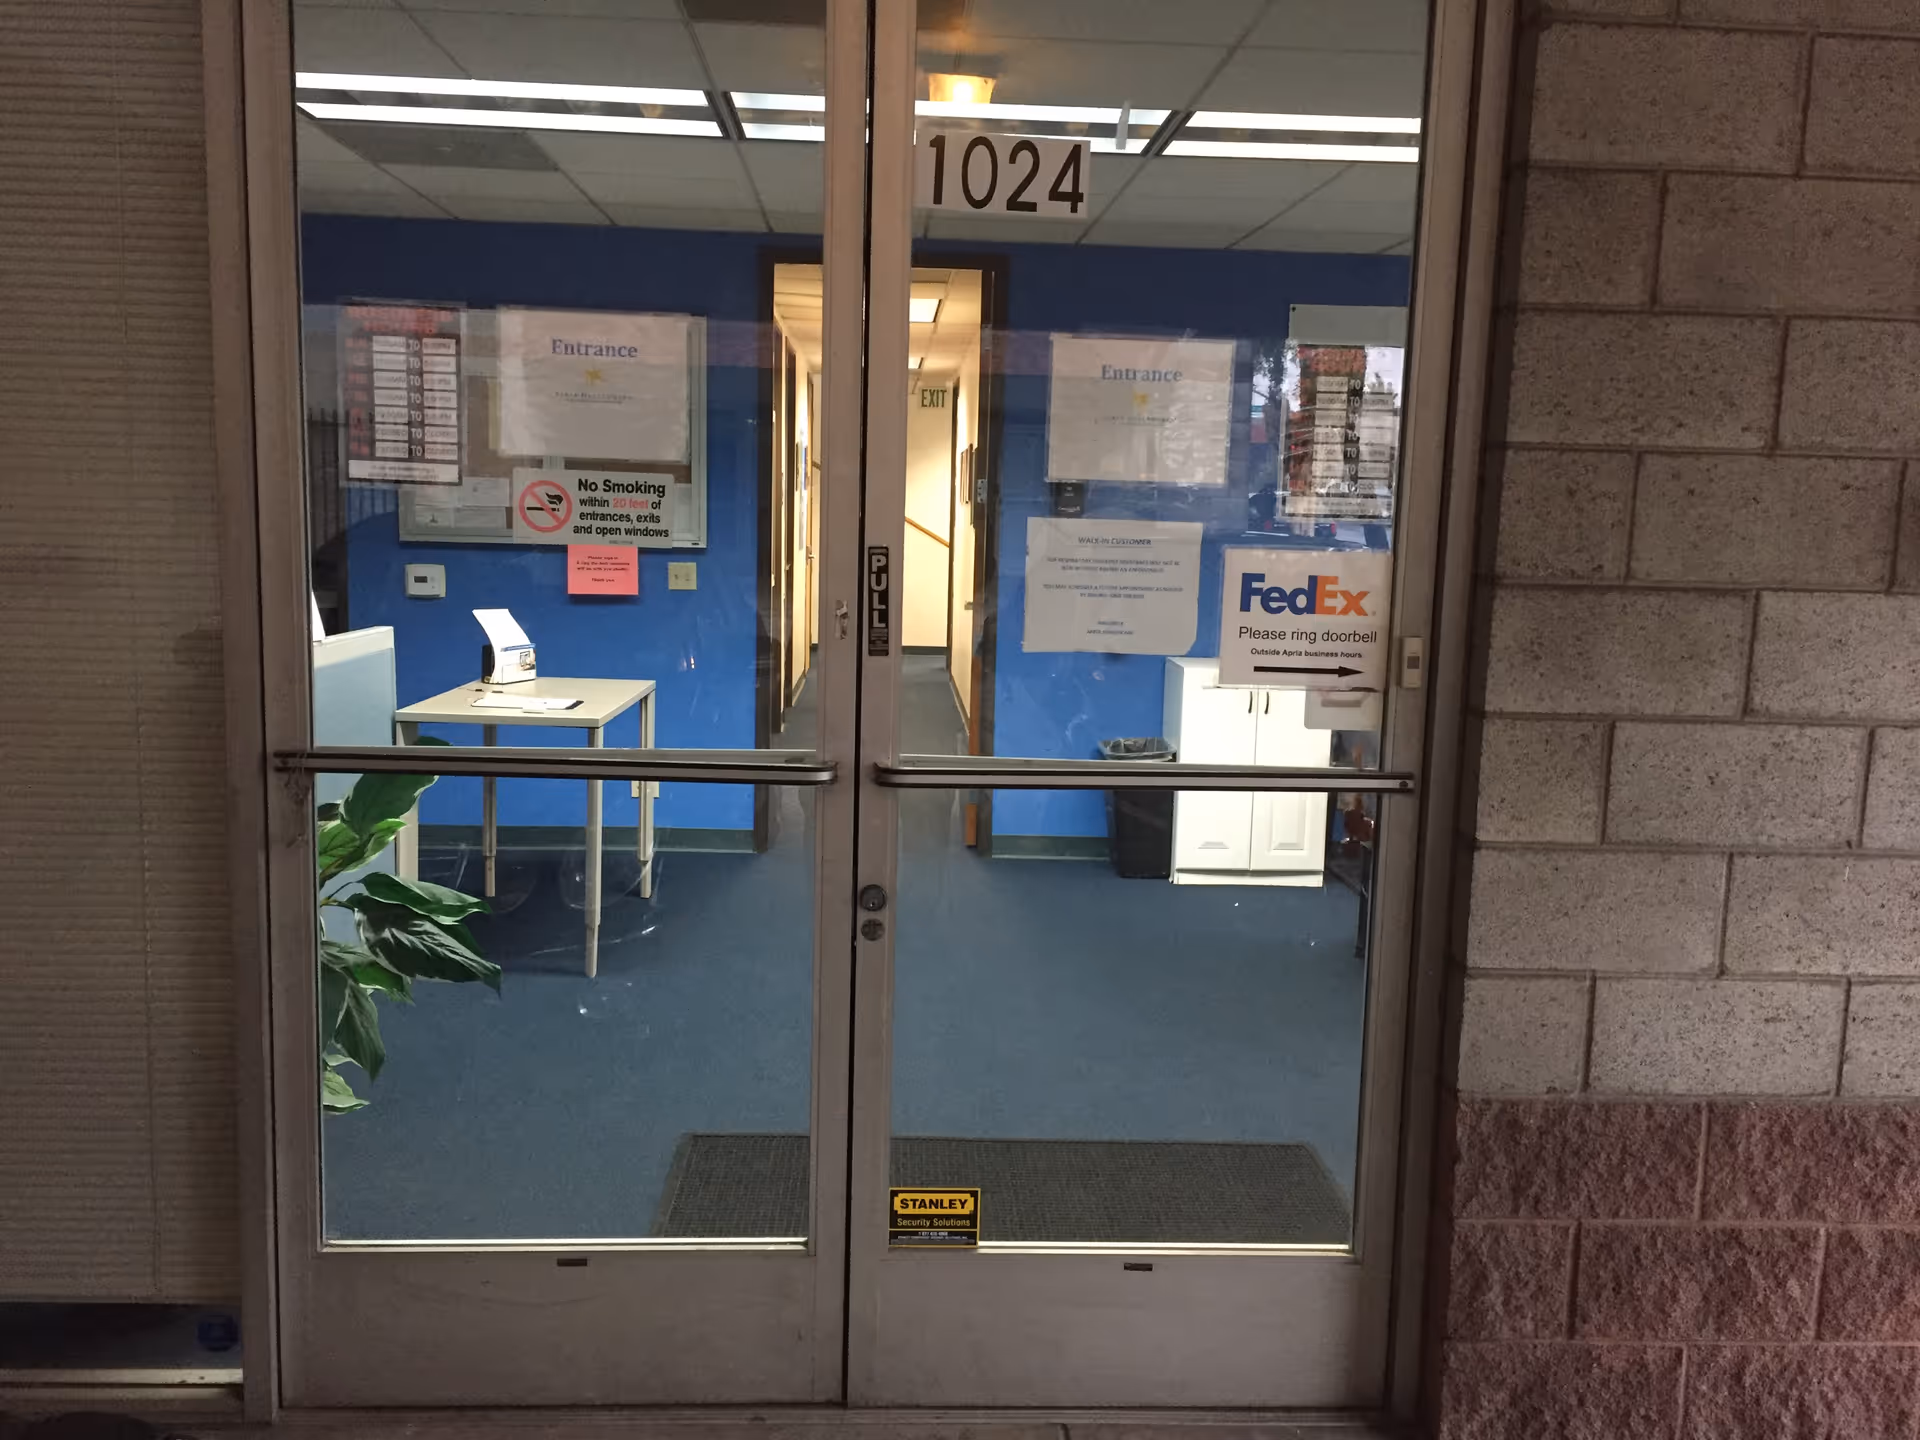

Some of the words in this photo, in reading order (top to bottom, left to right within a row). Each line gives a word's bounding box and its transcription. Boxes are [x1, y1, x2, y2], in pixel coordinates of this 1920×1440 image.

[929, 134, 1084, 213] 1024
[408, 339, 421, 351] TO
[551, 338, 638, 358] Entrance
[408, 357, 421, 369] TO
[1101, 364, 1183, 382] Entrance
[409, 375, 421, 386] TO
[409, 392, 422, 404] TO
[921, 388, 947, 408] EXIT
[410, 410, 422, 421] TO
[410, 428, 423, 439] TO
[411, 445, 423, 457] TO
[1345, 447, 1357, 458] TO
[578, 478, 599, 492] No
[602, 479, 666, 498] Smoking
[579, 496, 610, 508] within
[612, 497, 626, 508] 20
[629, 498, 648, 509] feet
[651, 499, 662, 510] of
[579, 510, 634, 524] entrances,
[636, 512, 661, 524] exits
[573, 524, 593, 535] and
[595, 526, 621, 537] open
[624, 526, 670, 538] windows
[1078, 536, 1110, 545] WALK-IN
[1111, 537, 1152, 546] CUSTOMER
[870, 554, 888, 628] PULL
[1239, 572, 1371, 617] FedEx
[1238, 626, 1286, 640] Please
[1291, 628, 1317, 644] ring
[1321, 629, 1378, 643] doorbell
[1250, 647, 1281, 656] Outside
[1282, 649, 1302, 657] Apria
[1304, 650, 1339, 658] business
[1340, 651, 1363, 659] hours
[900, 1198, 969, 1210] STANLEY
[897, 1218, 931, 1228] Security
[933, 1218, 971, 1227] Solutions
